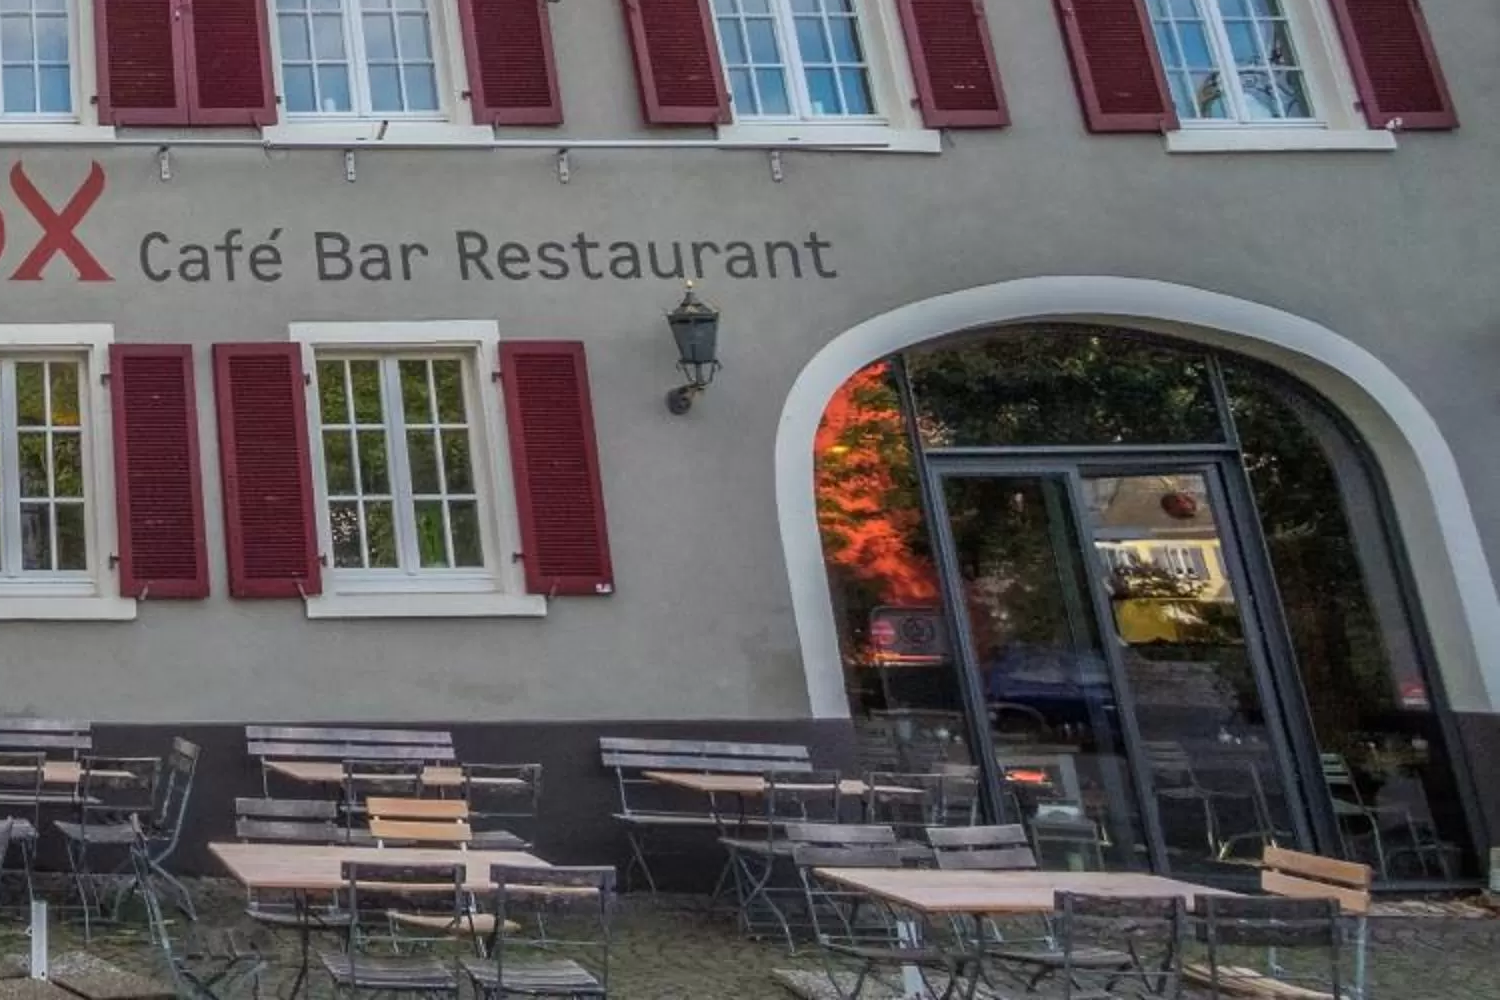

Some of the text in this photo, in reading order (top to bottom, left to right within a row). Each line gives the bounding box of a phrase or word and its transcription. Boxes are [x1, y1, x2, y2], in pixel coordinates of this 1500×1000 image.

[139, 228, 283, 283] Café
[314, 230, 430, 282] Bar
[456, 230, 838, 281] Restaurant
